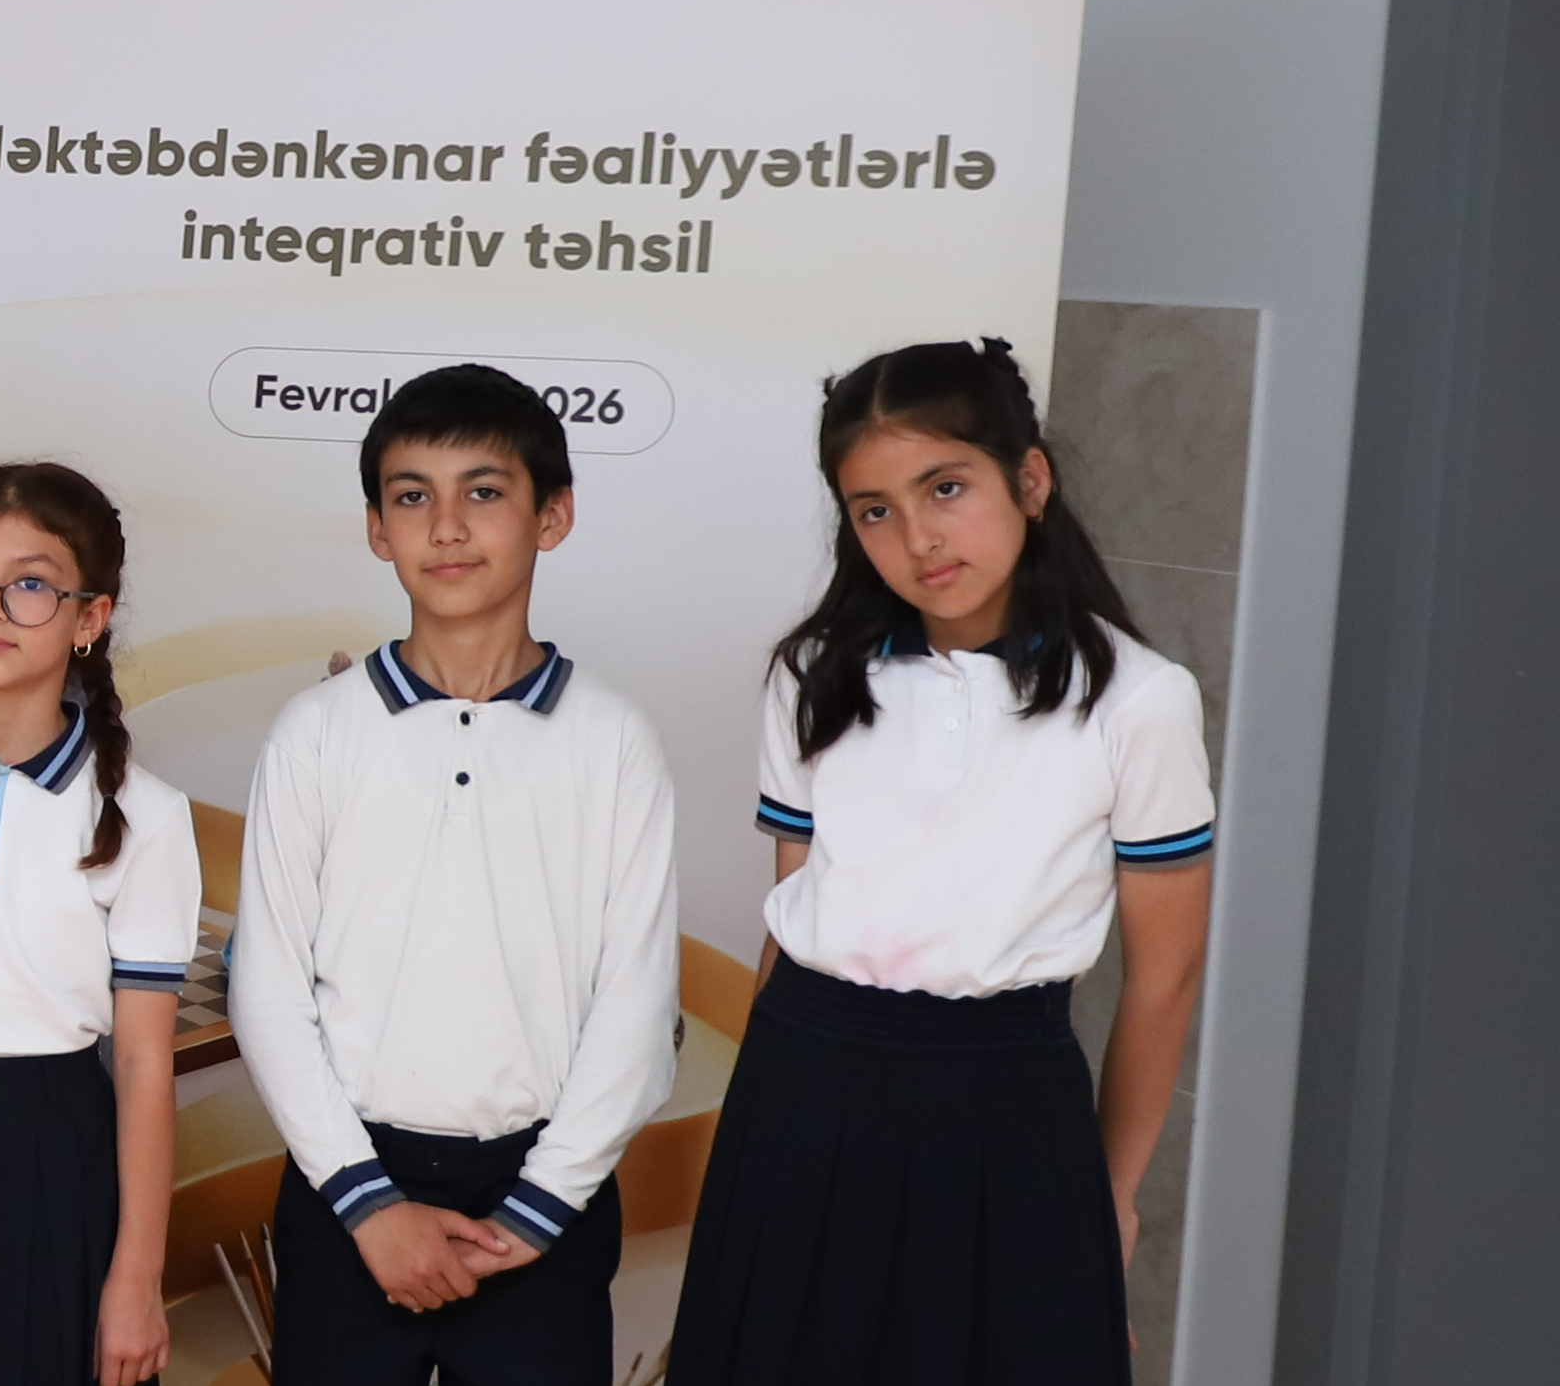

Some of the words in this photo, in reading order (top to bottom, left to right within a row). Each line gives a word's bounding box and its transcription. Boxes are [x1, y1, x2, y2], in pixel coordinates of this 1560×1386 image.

[524, 131, 997, 200] fəaliyyətlərlə
[182, 209, 505, 277] inteqrativ
[524, 219, 714, 273] təhsil
[254, 374, 392, 415] Fevral
[542, 385, 624, 424] 026
